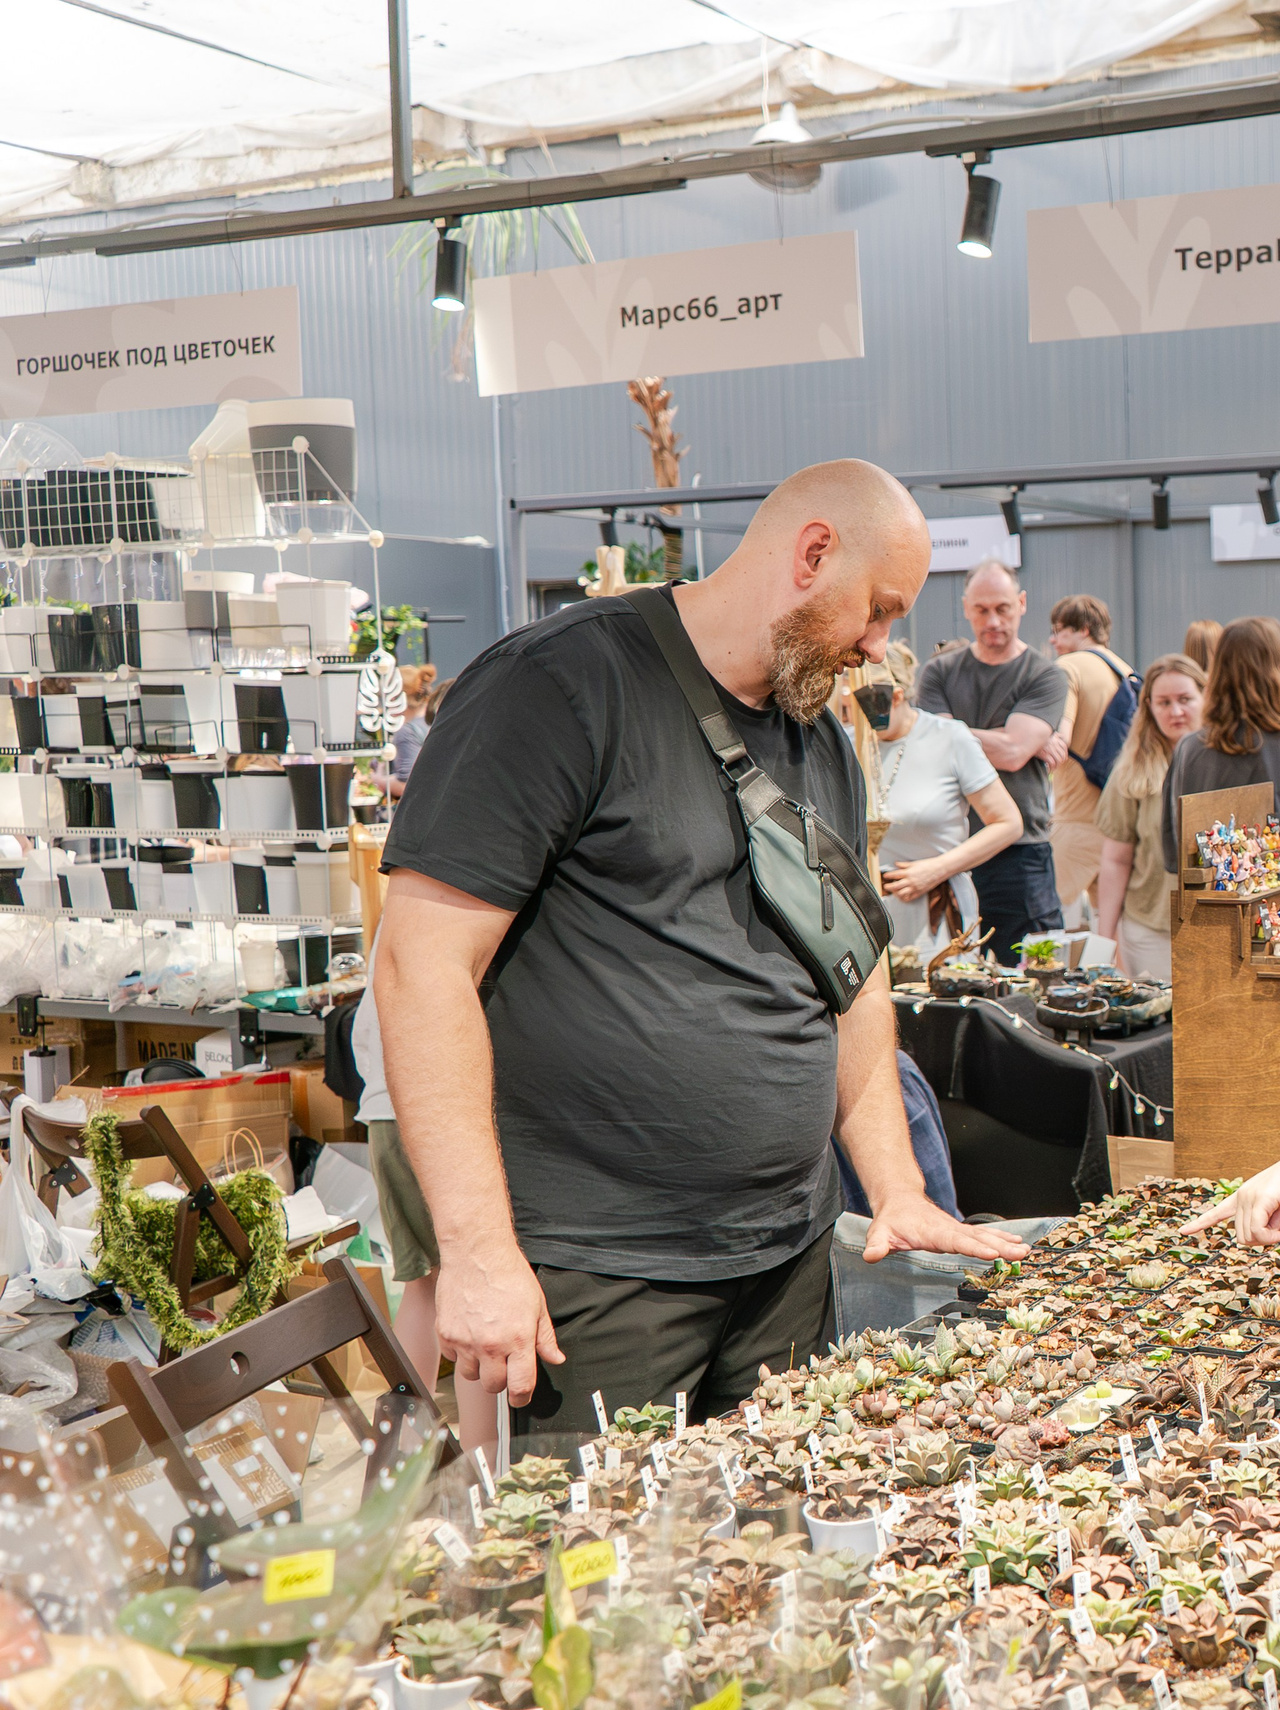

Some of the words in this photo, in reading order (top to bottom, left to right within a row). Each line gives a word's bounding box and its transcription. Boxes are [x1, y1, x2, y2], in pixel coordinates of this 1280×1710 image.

[620, 293, 783, 329] Марс66_арт
[16, 350, 120, 376] ГОРШОЧЕК
[126, 346, 168, 367] ПОД
[173, 335, 276, 365] ЦВЕТОЧЕК
[138, 1040, 177, 1062] MADE
